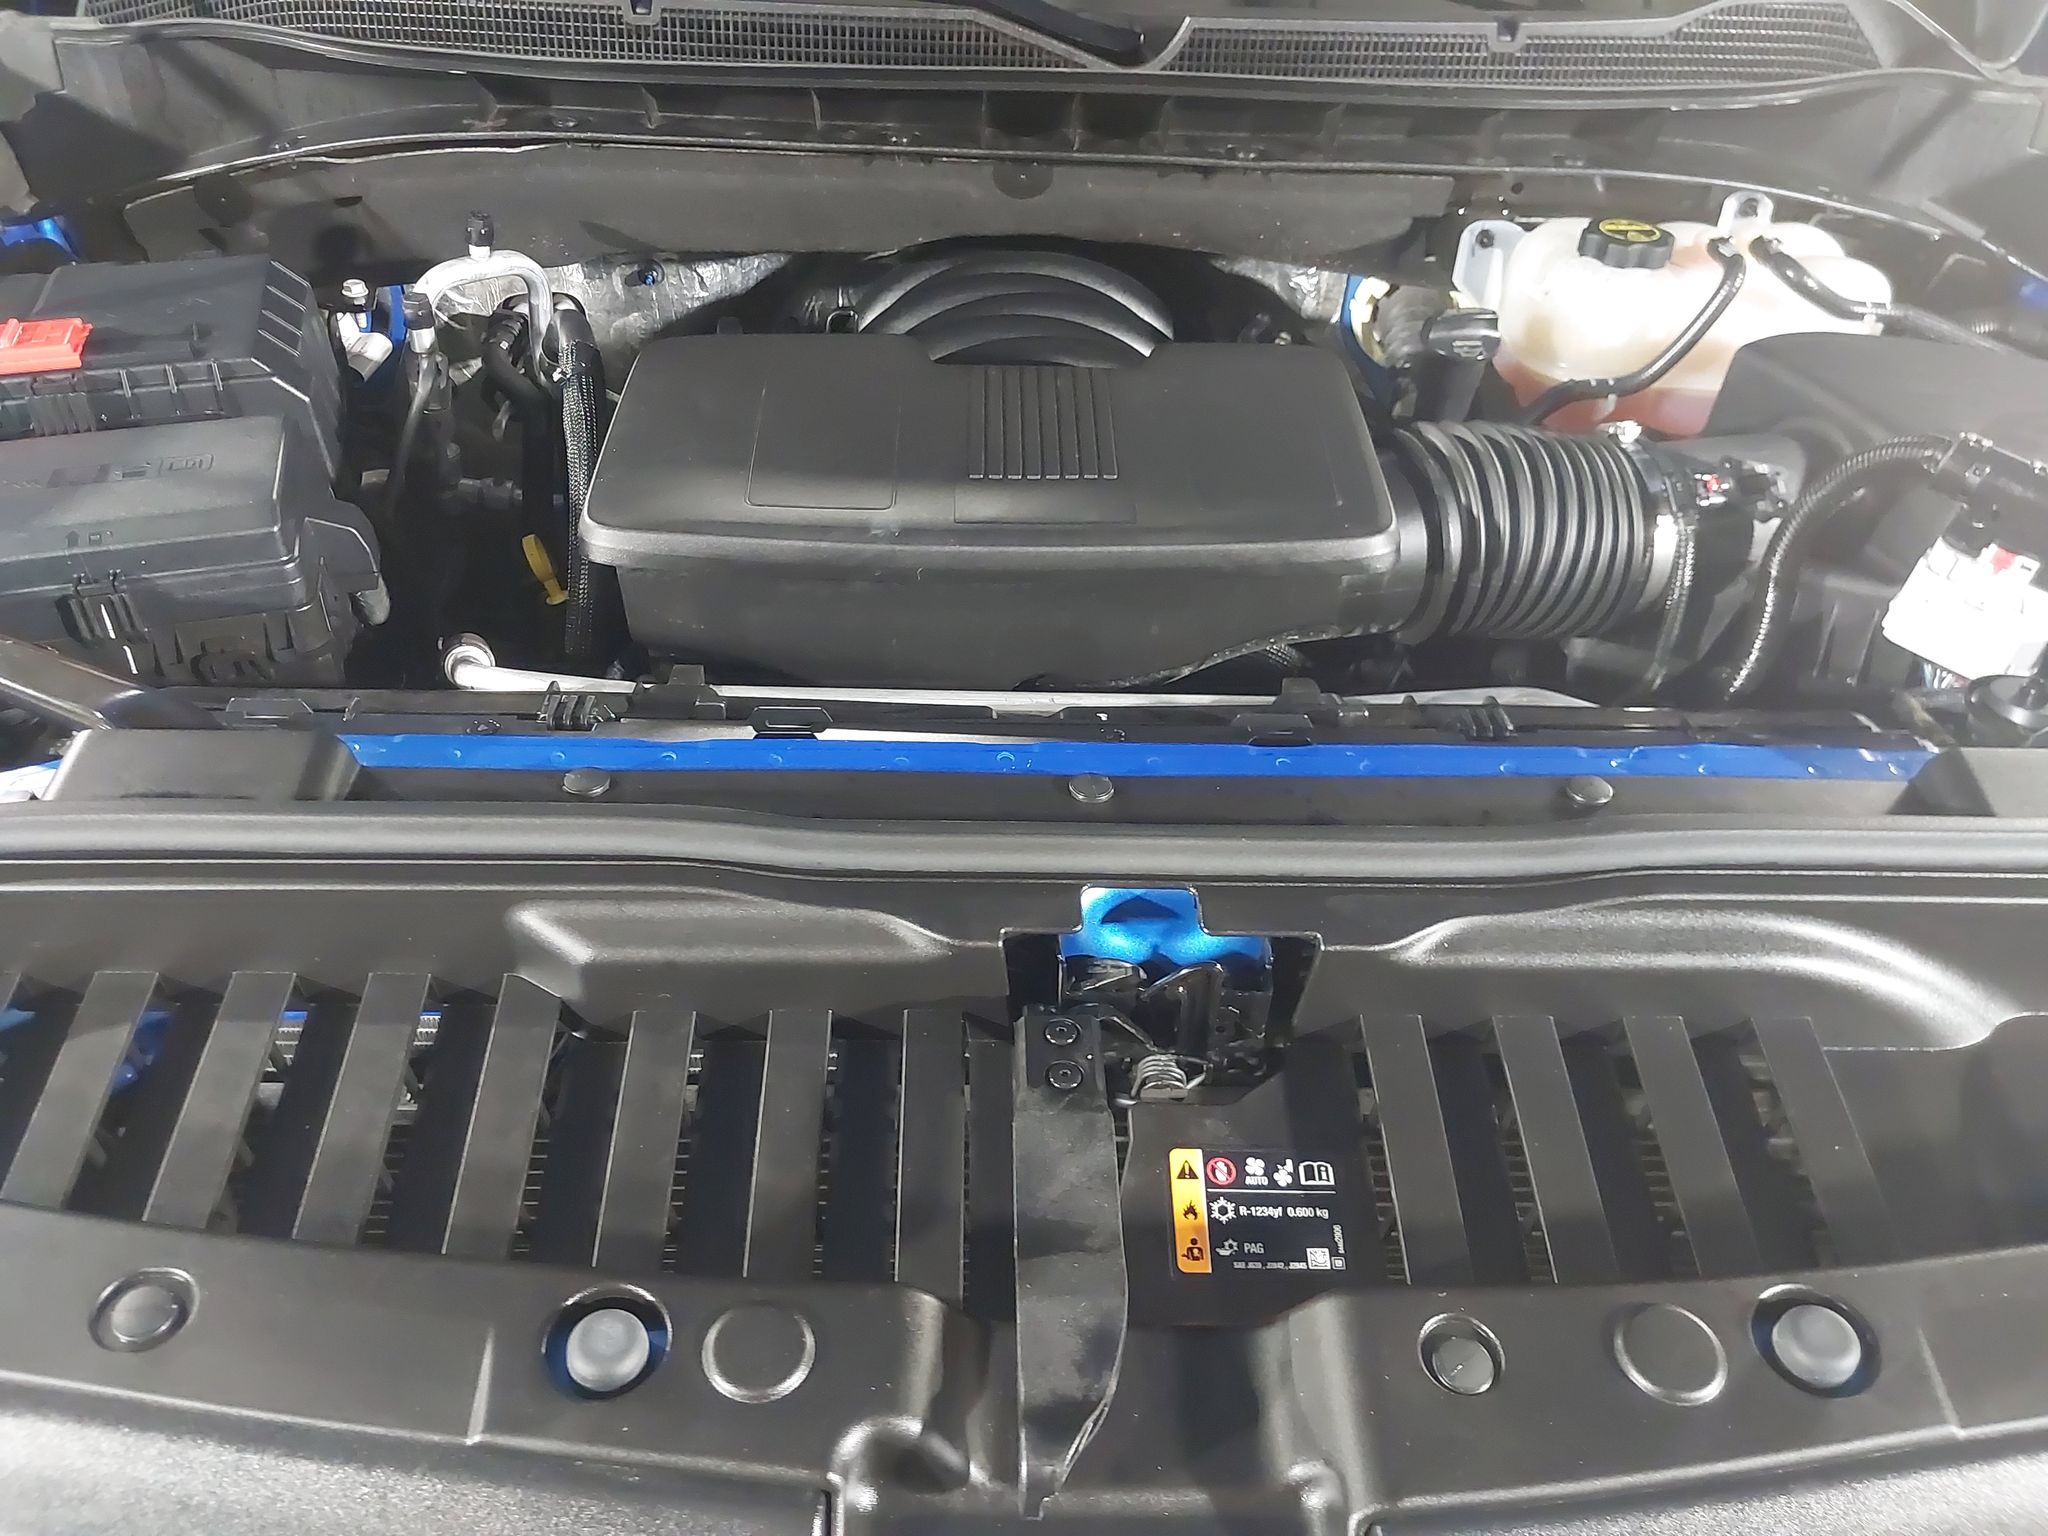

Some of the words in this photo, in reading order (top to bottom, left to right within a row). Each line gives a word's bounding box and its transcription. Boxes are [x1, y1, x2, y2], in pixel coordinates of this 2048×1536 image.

[1244, 1175, 1269, 1186] AUTO
[1286, 1206, 1315, 1218] 0.600
[1315, 1207, 1329, 1219] kg
[1243, 1242, 1265, 1254] PAG
